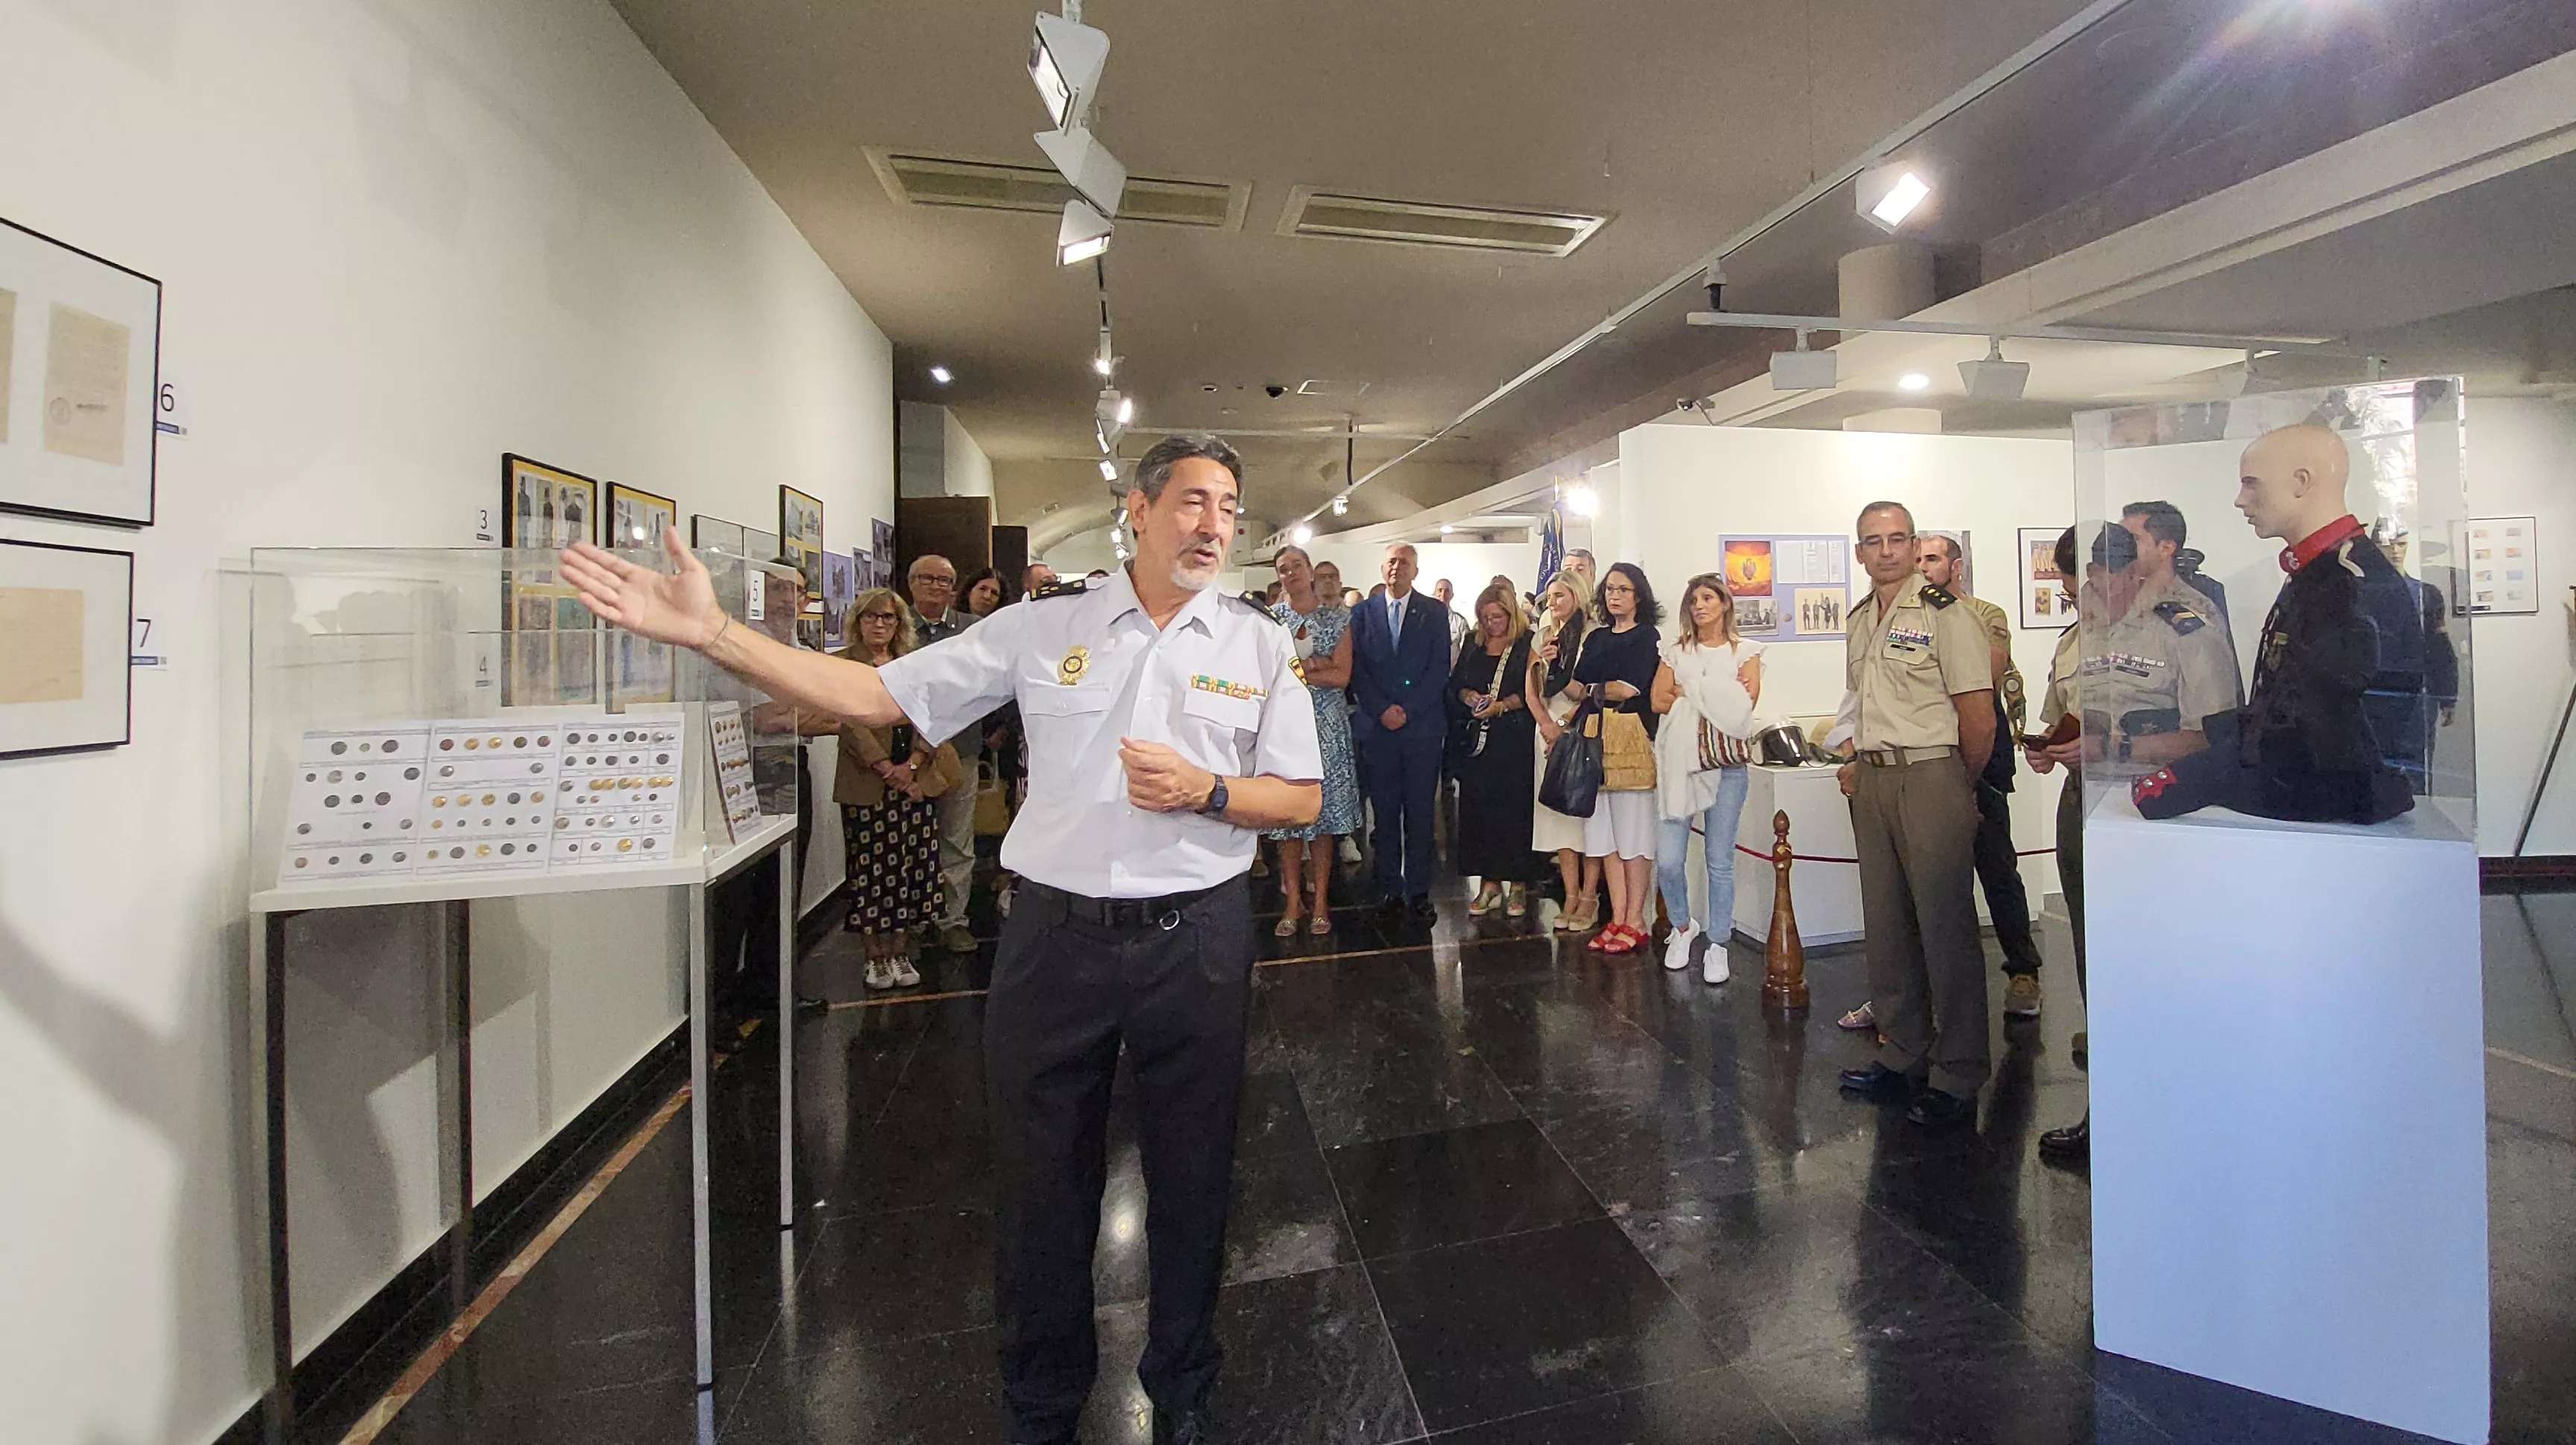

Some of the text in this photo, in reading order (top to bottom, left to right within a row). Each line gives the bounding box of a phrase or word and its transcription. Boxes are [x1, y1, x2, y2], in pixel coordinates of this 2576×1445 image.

[160, 383, 175, 412] 6
[480, 510, 488, 530] 3
[753, 580, 758, 602] 5
[136, 618, 152, 648] 7
[479, 656, 487, 676] 4
